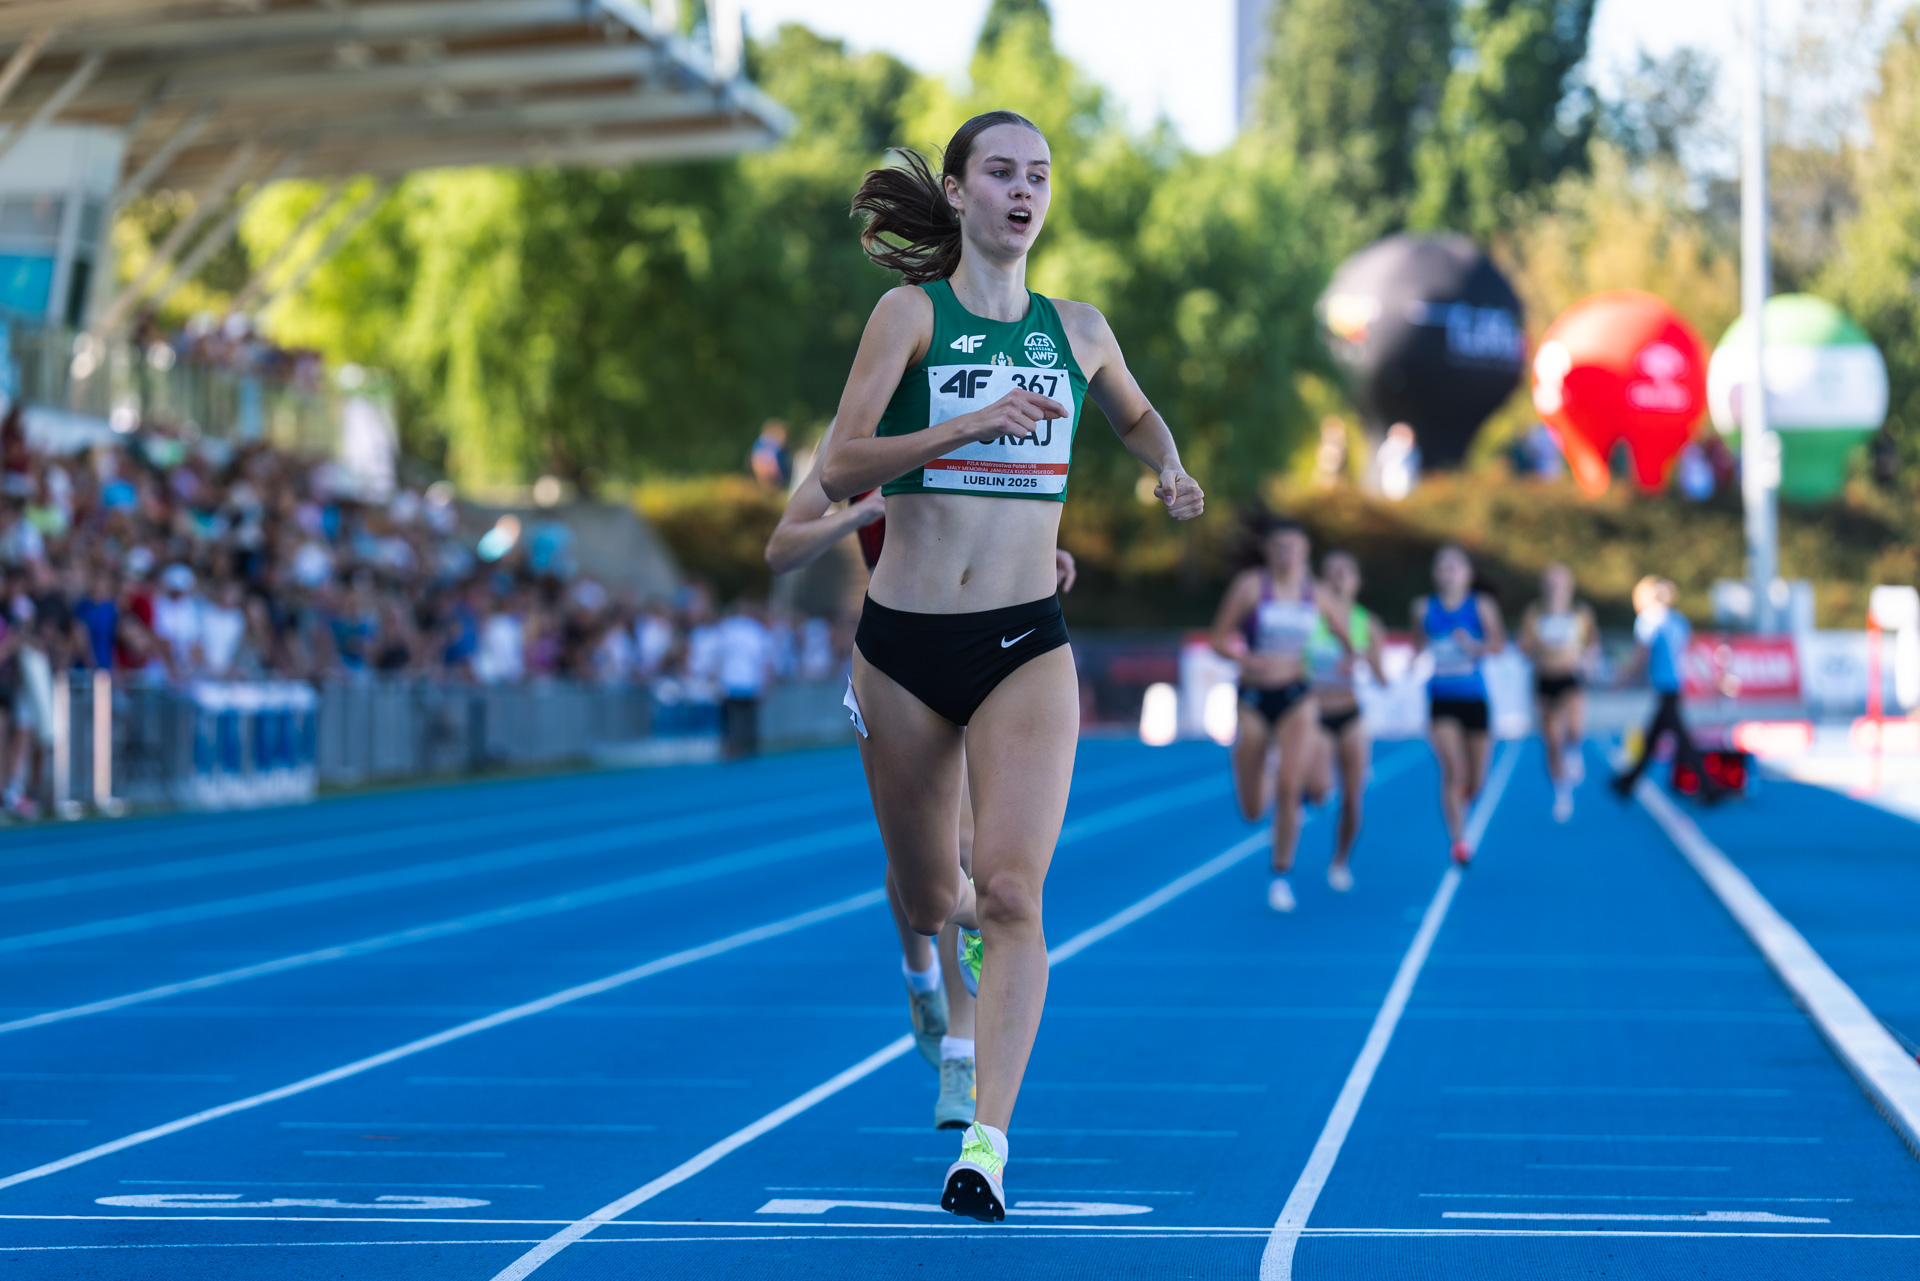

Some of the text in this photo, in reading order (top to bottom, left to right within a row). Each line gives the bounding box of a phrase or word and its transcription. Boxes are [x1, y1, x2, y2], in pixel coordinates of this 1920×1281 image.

[950, 334, 987, 354] 4F
[1030, 337, 1050, 347] AZS
[1032, 351, 1054, 361] AWF
[939, 369, 993, 399] 4F
[1011, 373, 1058, 397] 367
[963, 475, 1038, 487] LUBLIN 2025
